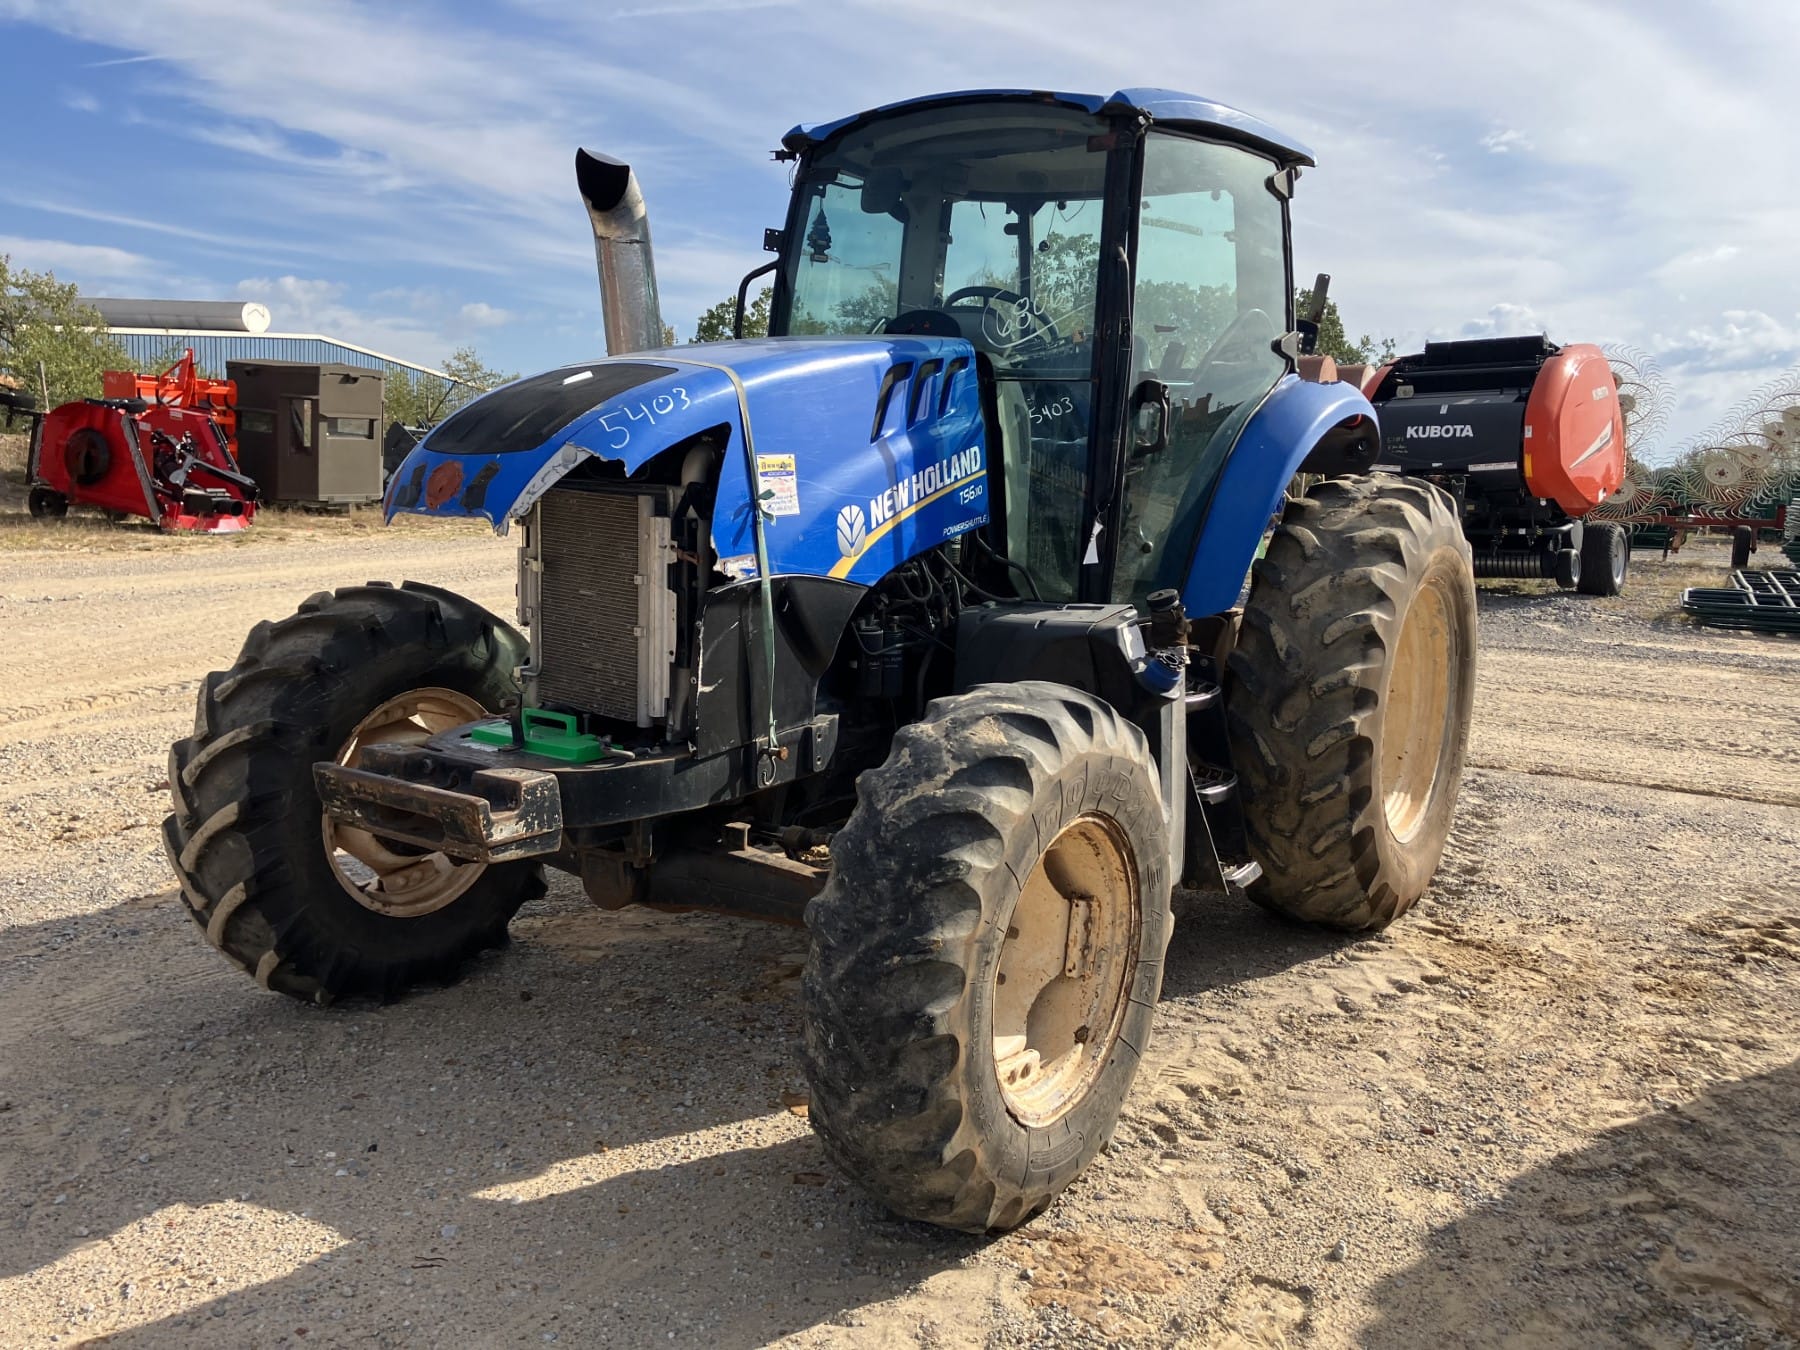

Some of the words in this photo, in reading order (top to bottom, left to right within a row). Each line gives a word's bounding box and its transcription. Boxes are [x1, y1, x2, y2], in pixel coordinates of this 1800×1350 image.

[598, 387, 691, 449] 5403
[1028, 396, 1074, 424] 5403
[1406, 424, 1474, 439] KUBOTA
[869, 478, 909, 530] NEW
[911, 445, 981, 503] HOLLAND
[942, 513, 988, 537] POWERSHUTTLE
